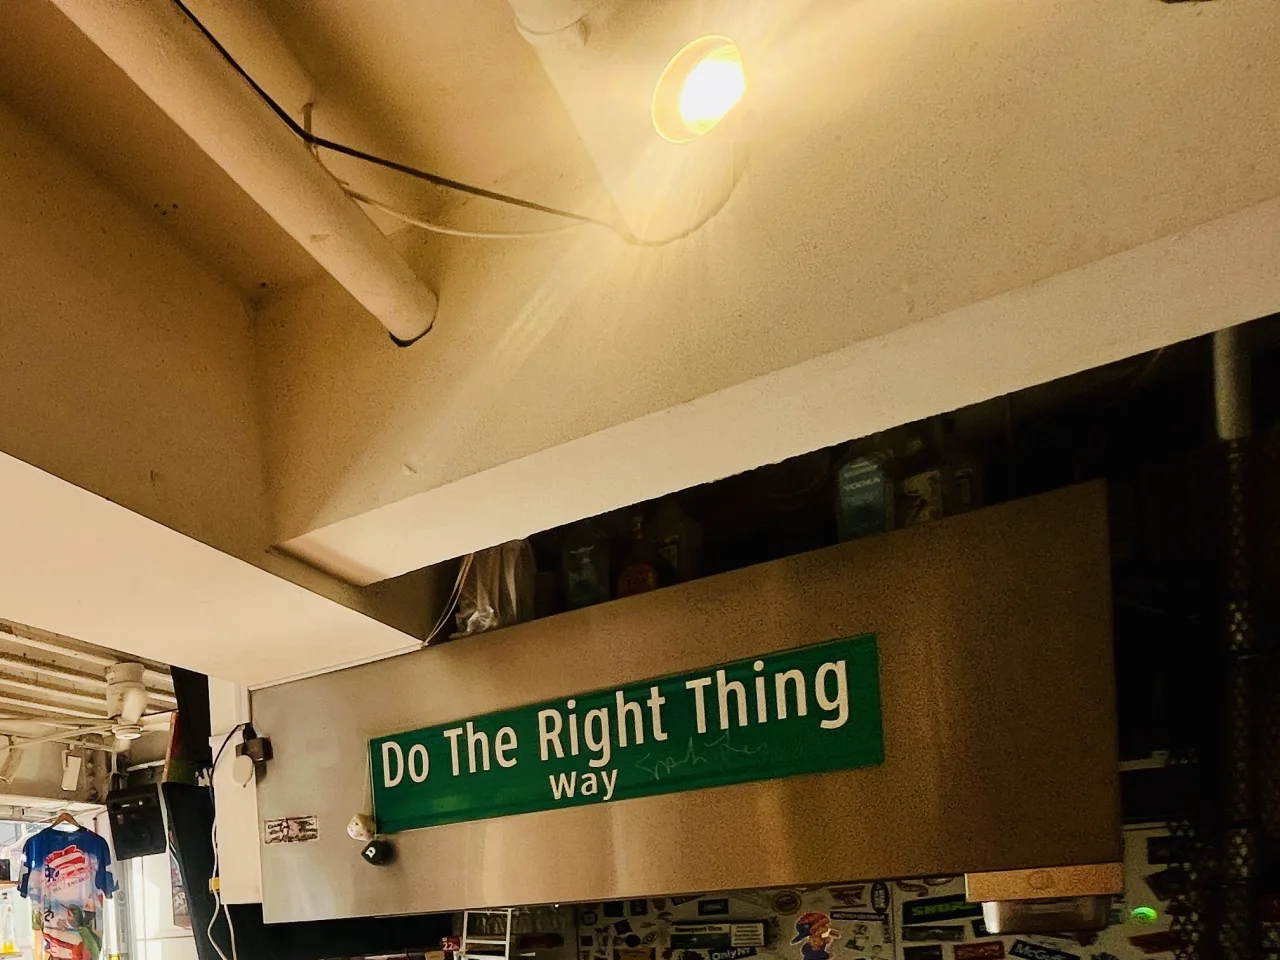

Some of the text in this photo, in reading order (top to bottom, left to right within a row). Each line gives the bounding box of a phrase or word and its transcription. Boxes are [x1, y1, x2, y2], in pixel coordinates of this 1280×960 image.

[381, 659, 849, 788] Do The Right Thing
